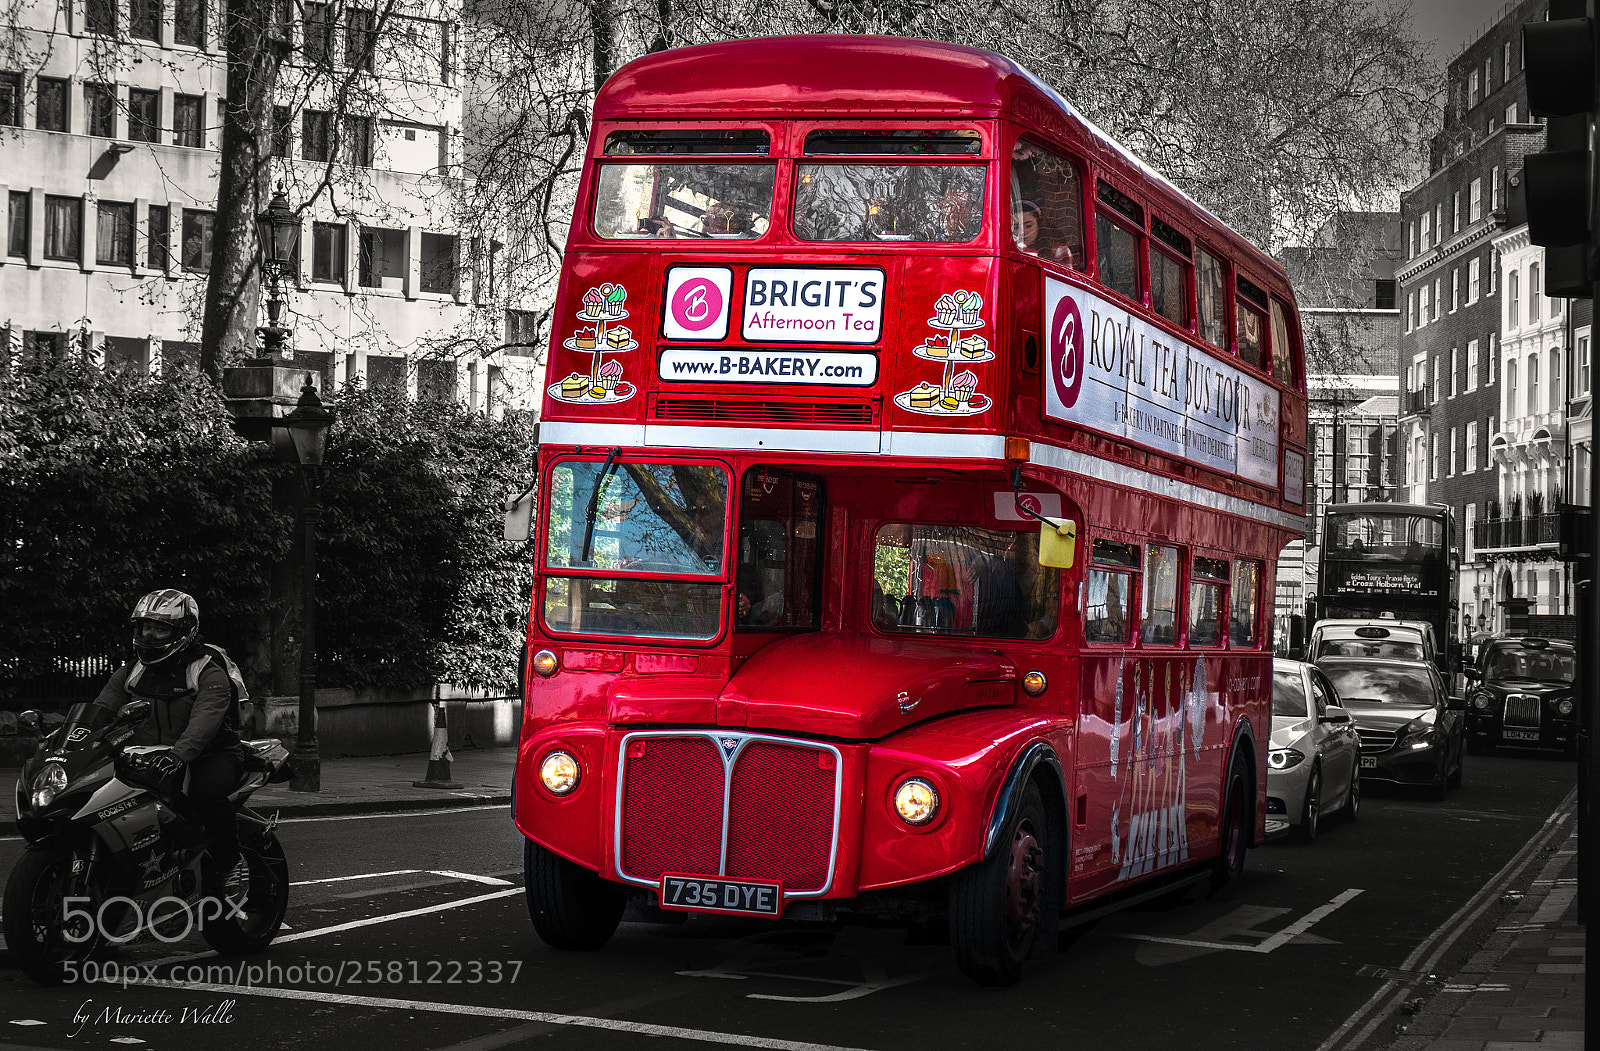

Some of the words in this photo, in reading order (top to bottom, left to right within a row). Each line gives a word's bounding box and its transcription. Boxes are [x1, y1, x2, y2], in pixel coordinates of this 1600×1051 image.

[750, 279, 877, 309] BRIGIT'S
[748, 312, 836, 331] Afternoon
[842, 313, 874, 332] Tea
[672, 357, 862, 379] www.B-BAKERY.com
[1089, 309, 1145, 386] ROYAL
[1152, 340, 1179, 401] TEA
[1185, 356, 1210, 413] BUS
[1216, 372, 1251, 431] TOUR
[67, 727, 91, 742] 9
[669, 880, 718, 906] 735
[723, 884, 772, 911] DYE
